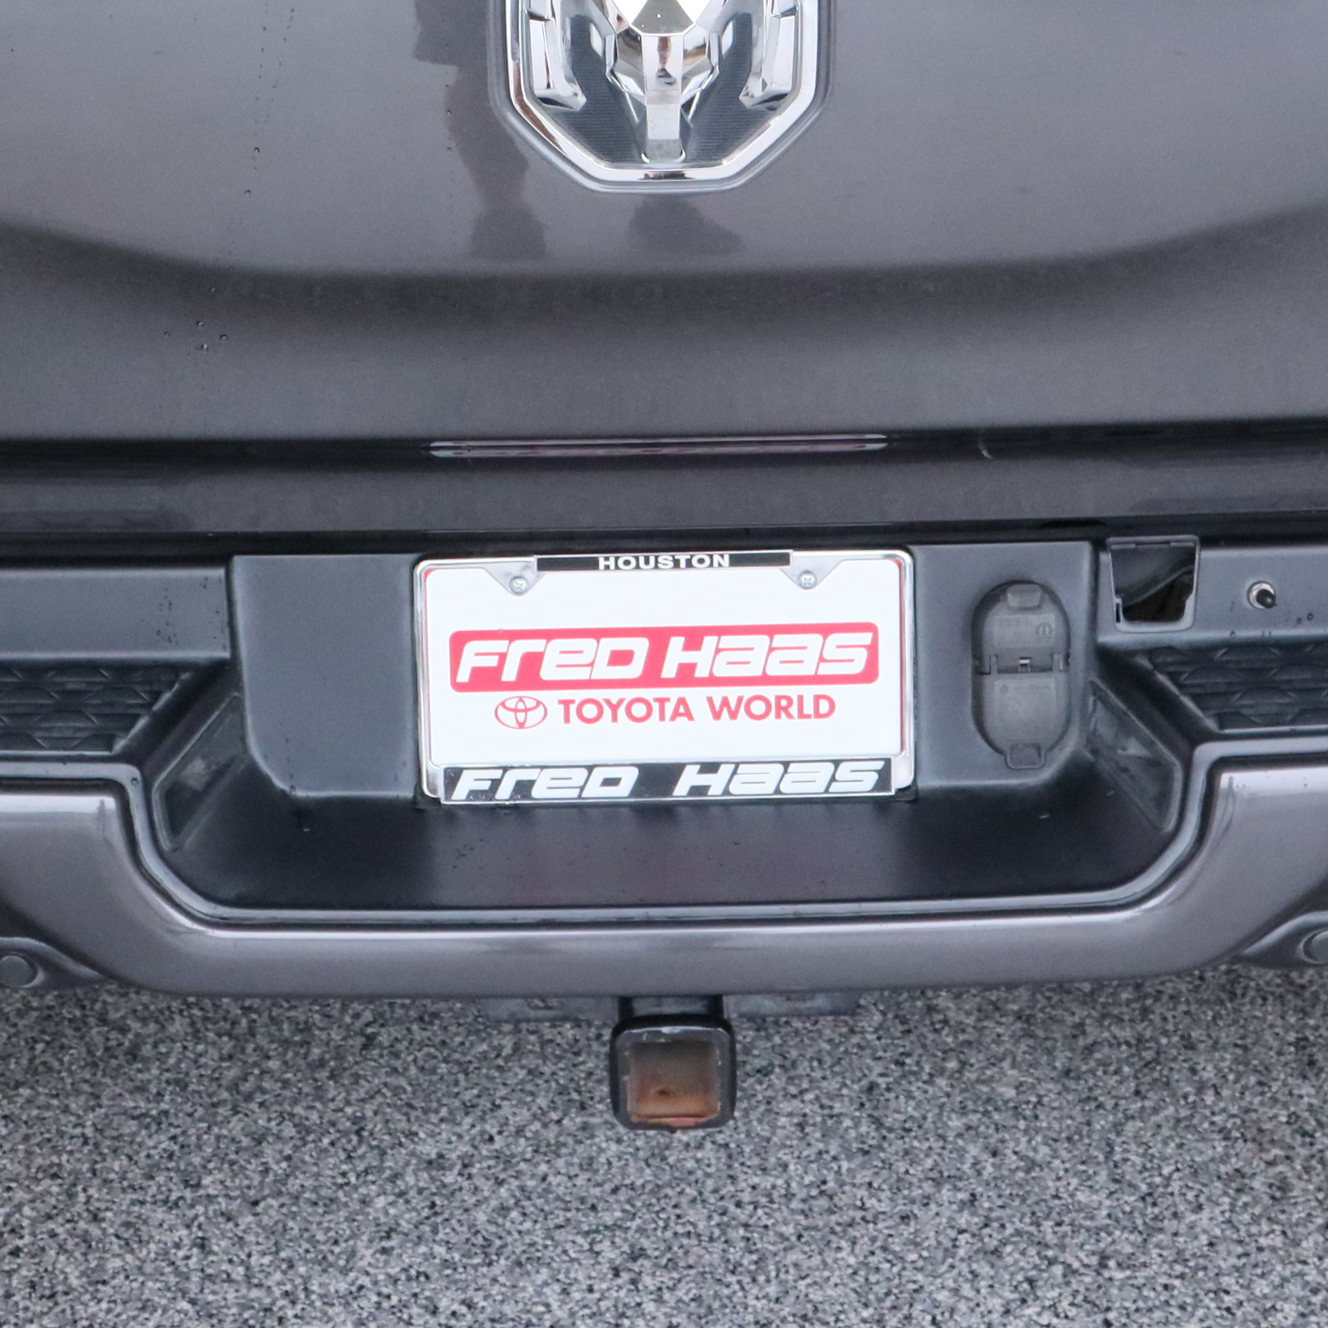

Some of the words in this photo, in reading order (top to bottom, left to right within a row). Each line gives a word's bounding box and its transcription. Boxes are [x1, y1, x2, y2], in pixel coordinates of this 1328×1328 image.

[598, 554, 730, 571] HOUSTON
[558, 696, 695, 726] TOYOTA
[706, 693, 837, 721] WORLD
